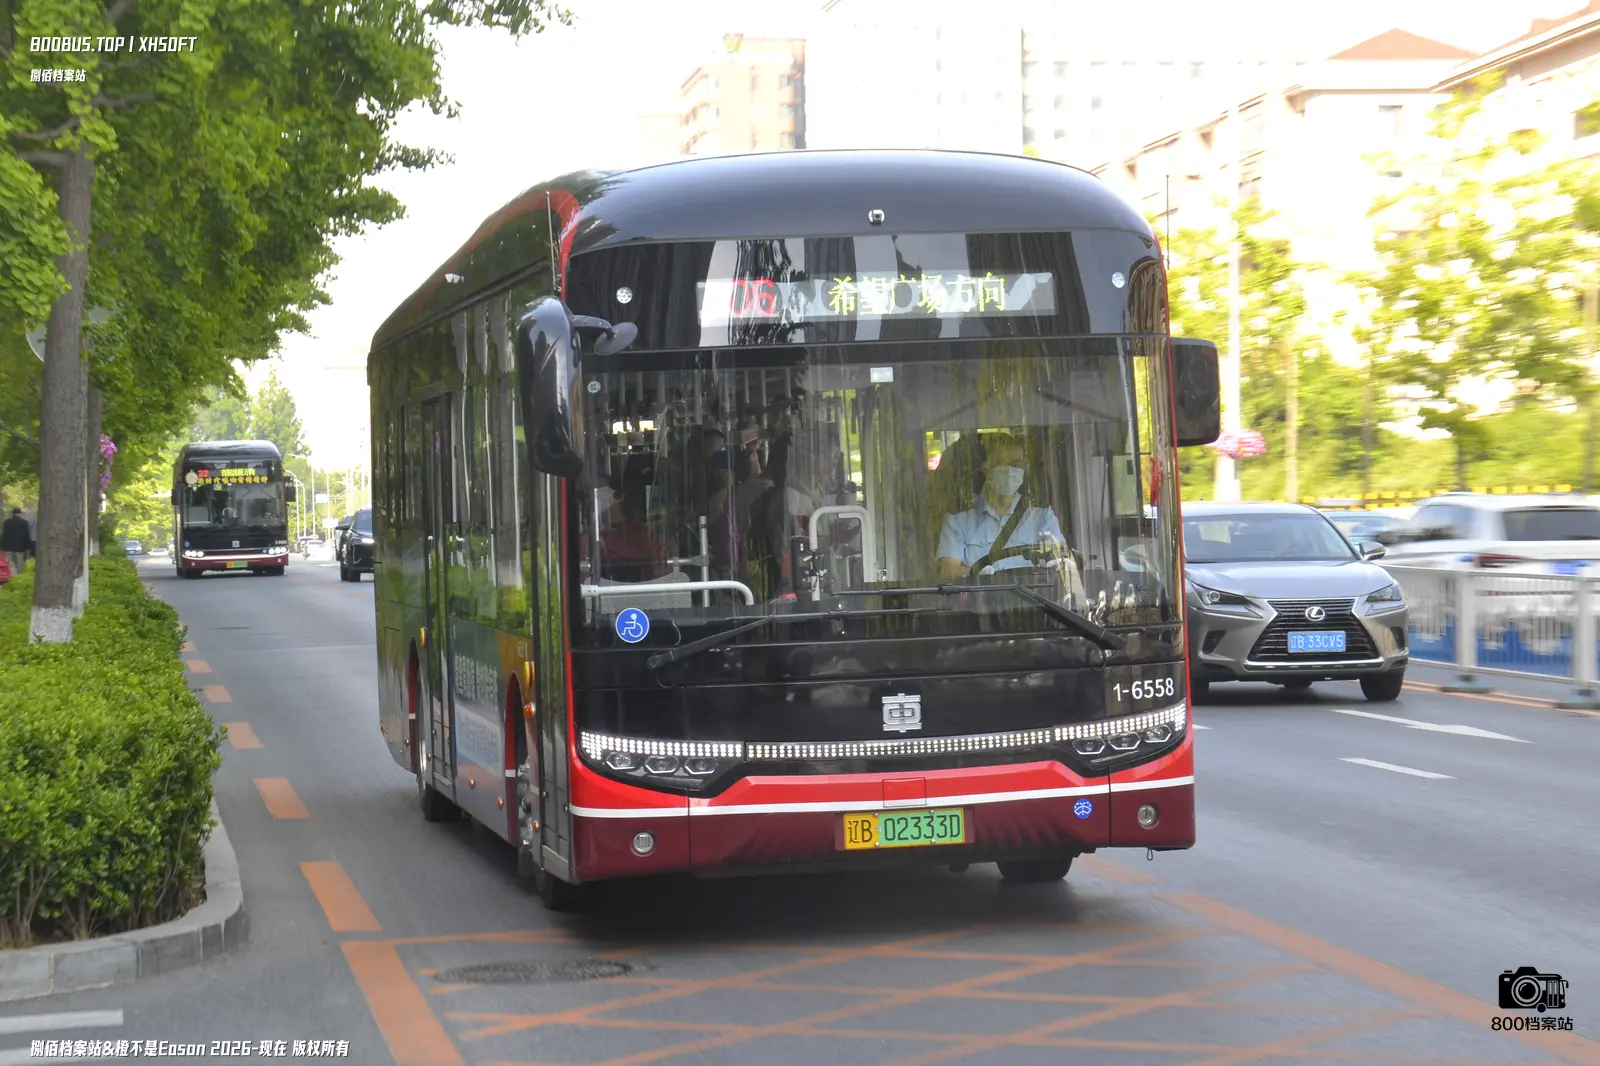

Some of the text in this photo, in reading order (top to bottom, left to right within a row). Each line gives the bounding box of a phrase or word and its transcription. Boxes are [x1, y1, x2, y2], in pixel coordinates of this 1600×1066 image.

[828, 272, 1006, 316] 希望广场方向
[1113, 677, 1174, 701] 1-6558
